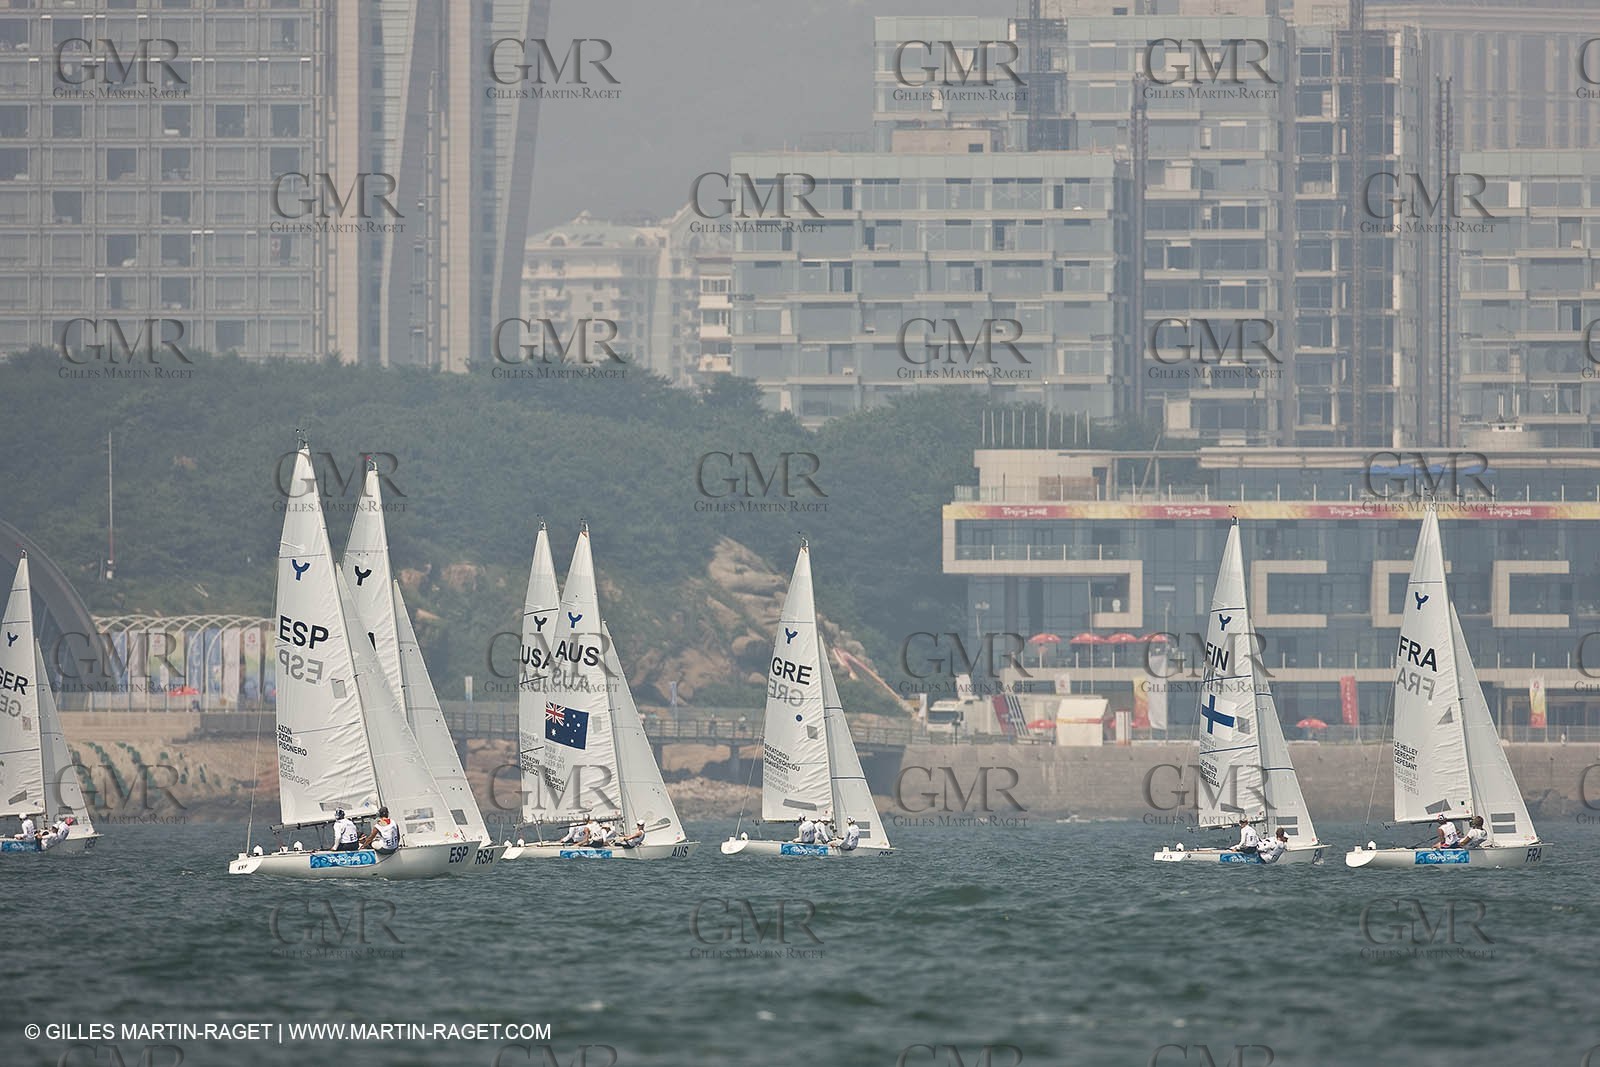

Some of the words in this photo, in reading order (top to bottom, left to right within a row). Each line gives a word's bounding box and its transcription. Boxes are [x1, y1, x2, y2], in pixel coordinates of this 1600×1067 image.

[280, 615, 329, 649] ESP
[555, 640, 599, 667] AUS
[1205, 642, 1229, 671] FIN
[1399, 635, 1437, 672] FRA
[772, 656, 812, 685] GRE
[449, 846, 468, 863] ESP
[475, 849, 495, 865] RSA
[672, 845, 689, 858] AUS
[1526, 848, 1542, 862] FRA
